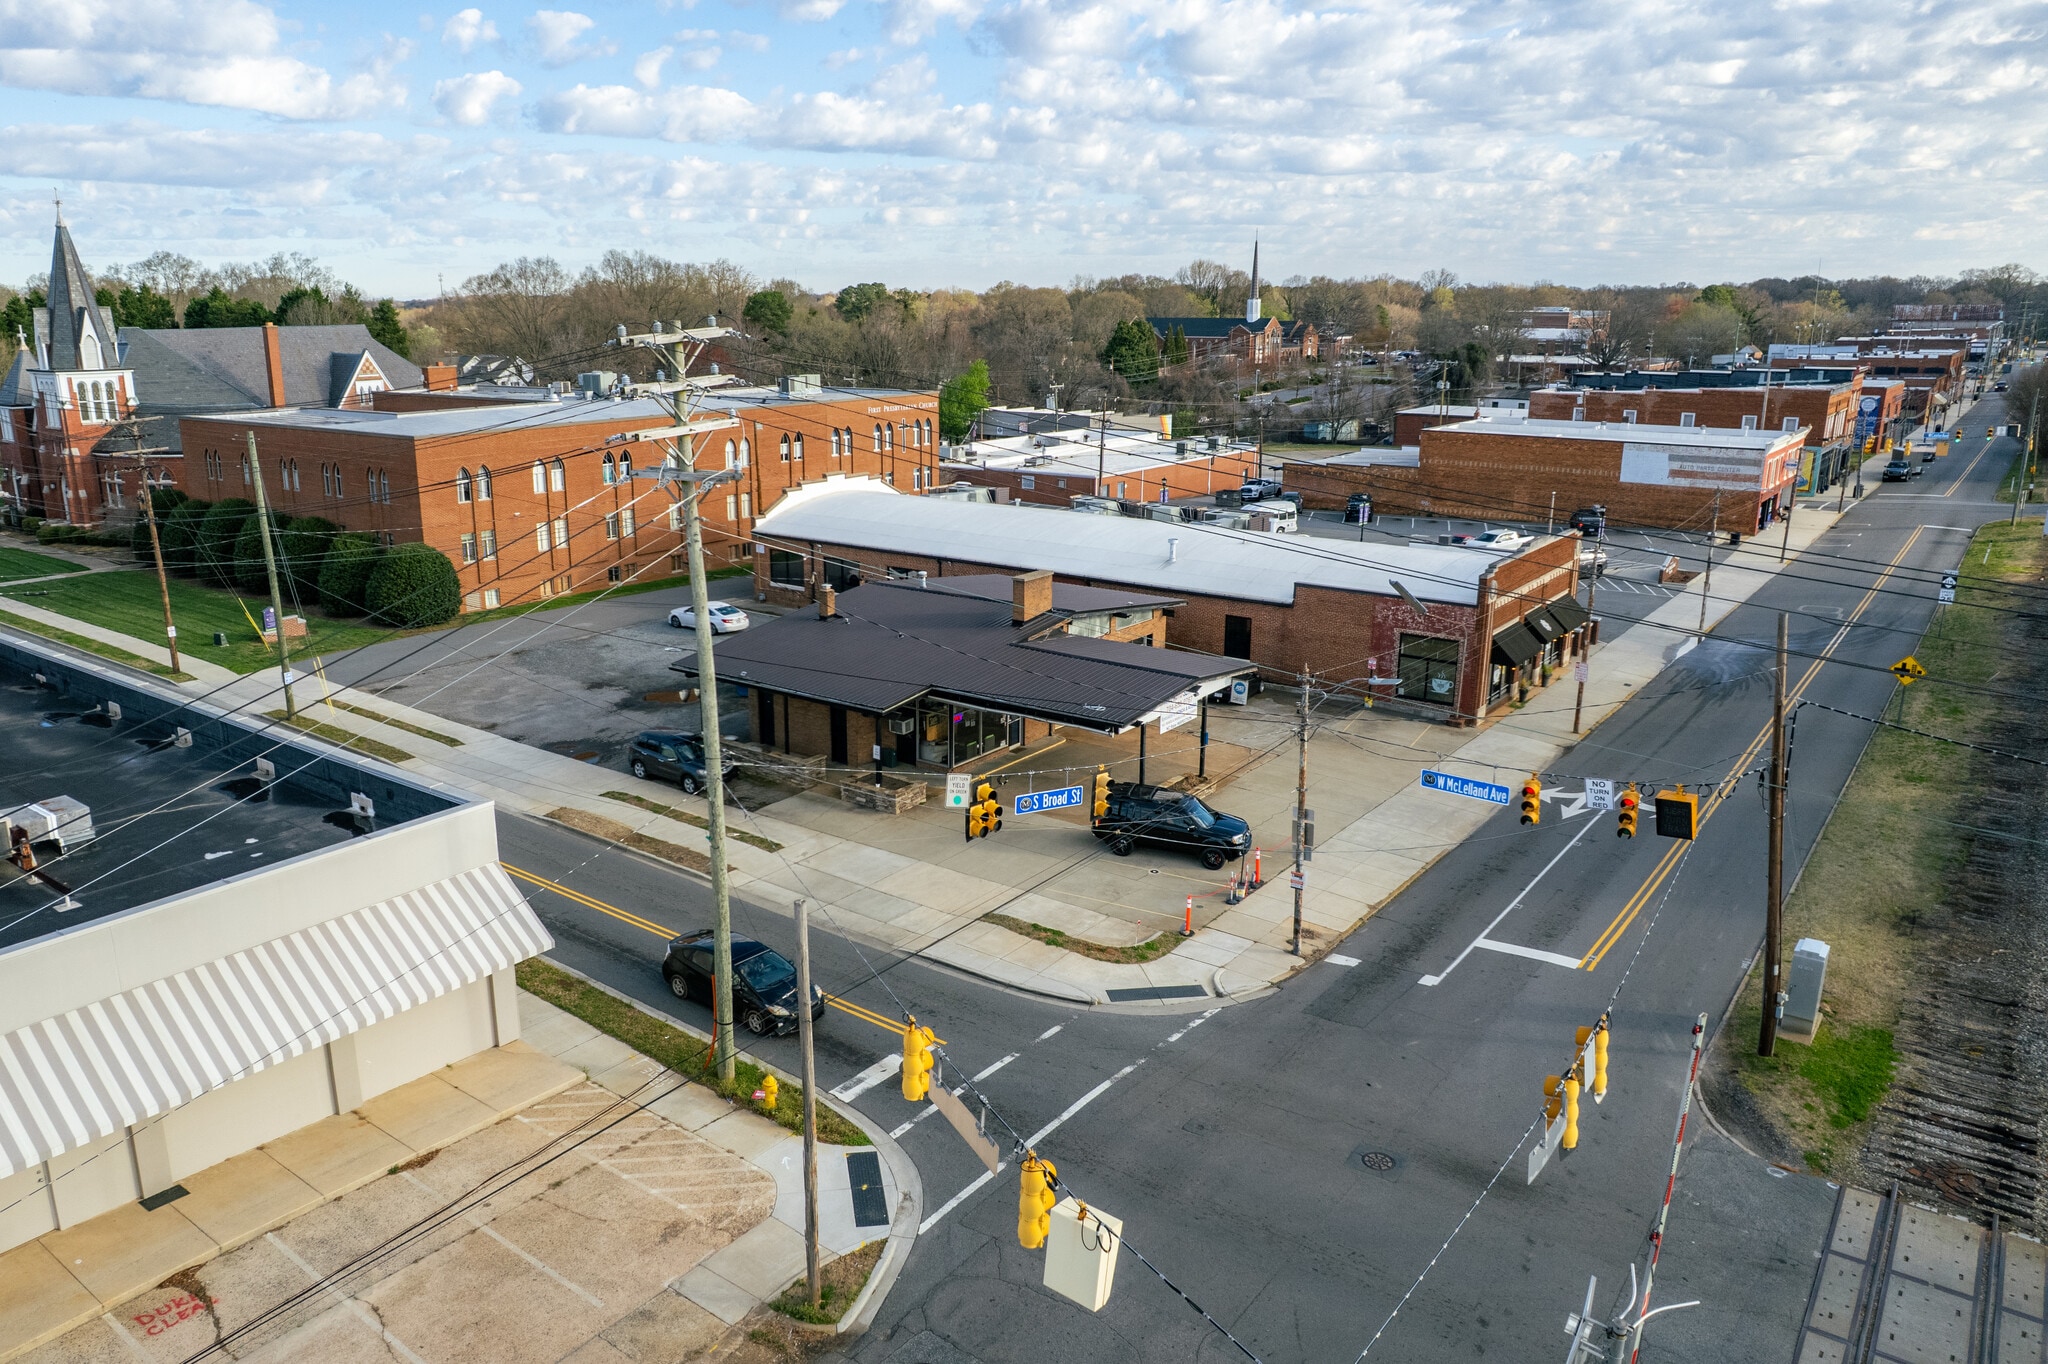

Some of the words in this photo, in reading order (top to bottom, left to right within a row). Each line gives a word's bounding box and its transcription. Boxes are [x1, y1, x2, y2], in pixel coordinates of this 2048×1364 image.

[1032, 795, 1039, 809] S
[1043, 792, 1068, 808] Broad
[1071, 788, 1081, 803] St
[1437, 775, 1445, 790] W
[1447, 778, 1489, 799] McLelland
[1489, 787, 1507, 803] Ave
[1589, 788, 1609, 796] TURN
